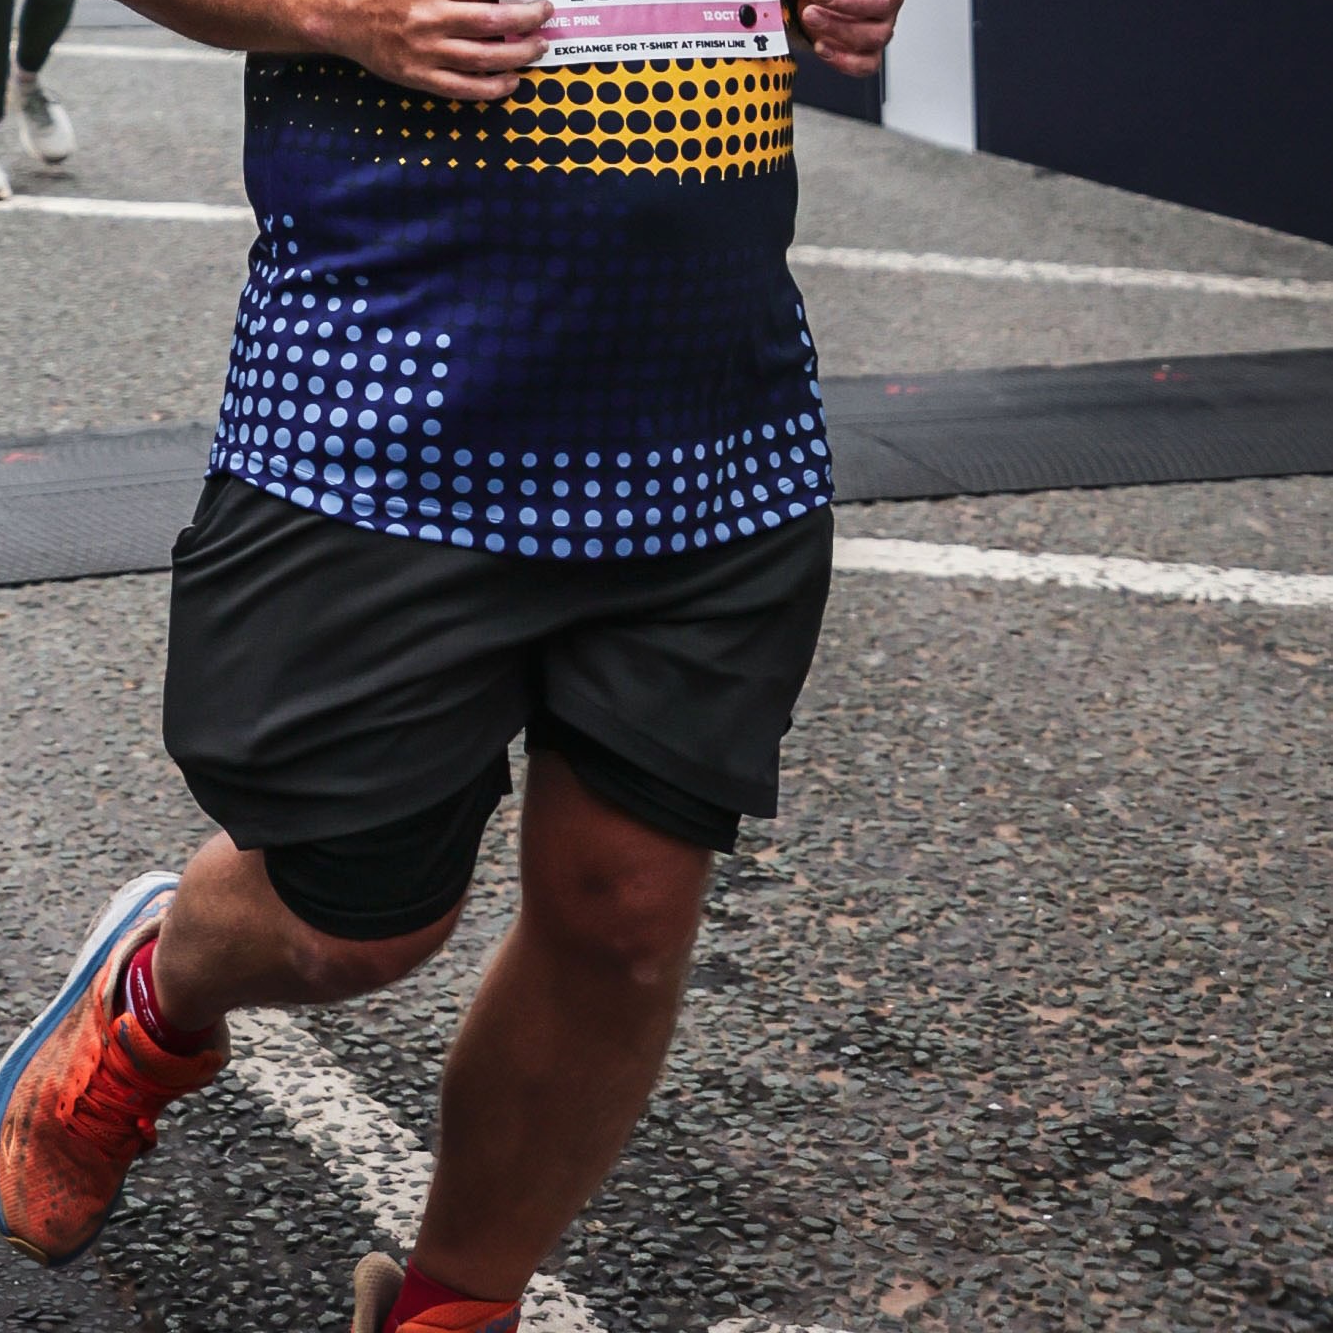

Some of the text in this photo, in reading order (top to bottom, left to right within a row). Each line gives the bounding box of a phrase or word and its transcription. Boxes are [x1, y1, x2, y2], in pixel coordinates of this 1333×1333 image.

[541, 15, 601, 29] AVE: PINK
[703, 10, 714, 21] 12
[714, 10, 735, 21] OCT
[554, 39, 746, 56] EXCHANGE FOR T-SHIRT AT FINISH LINE
